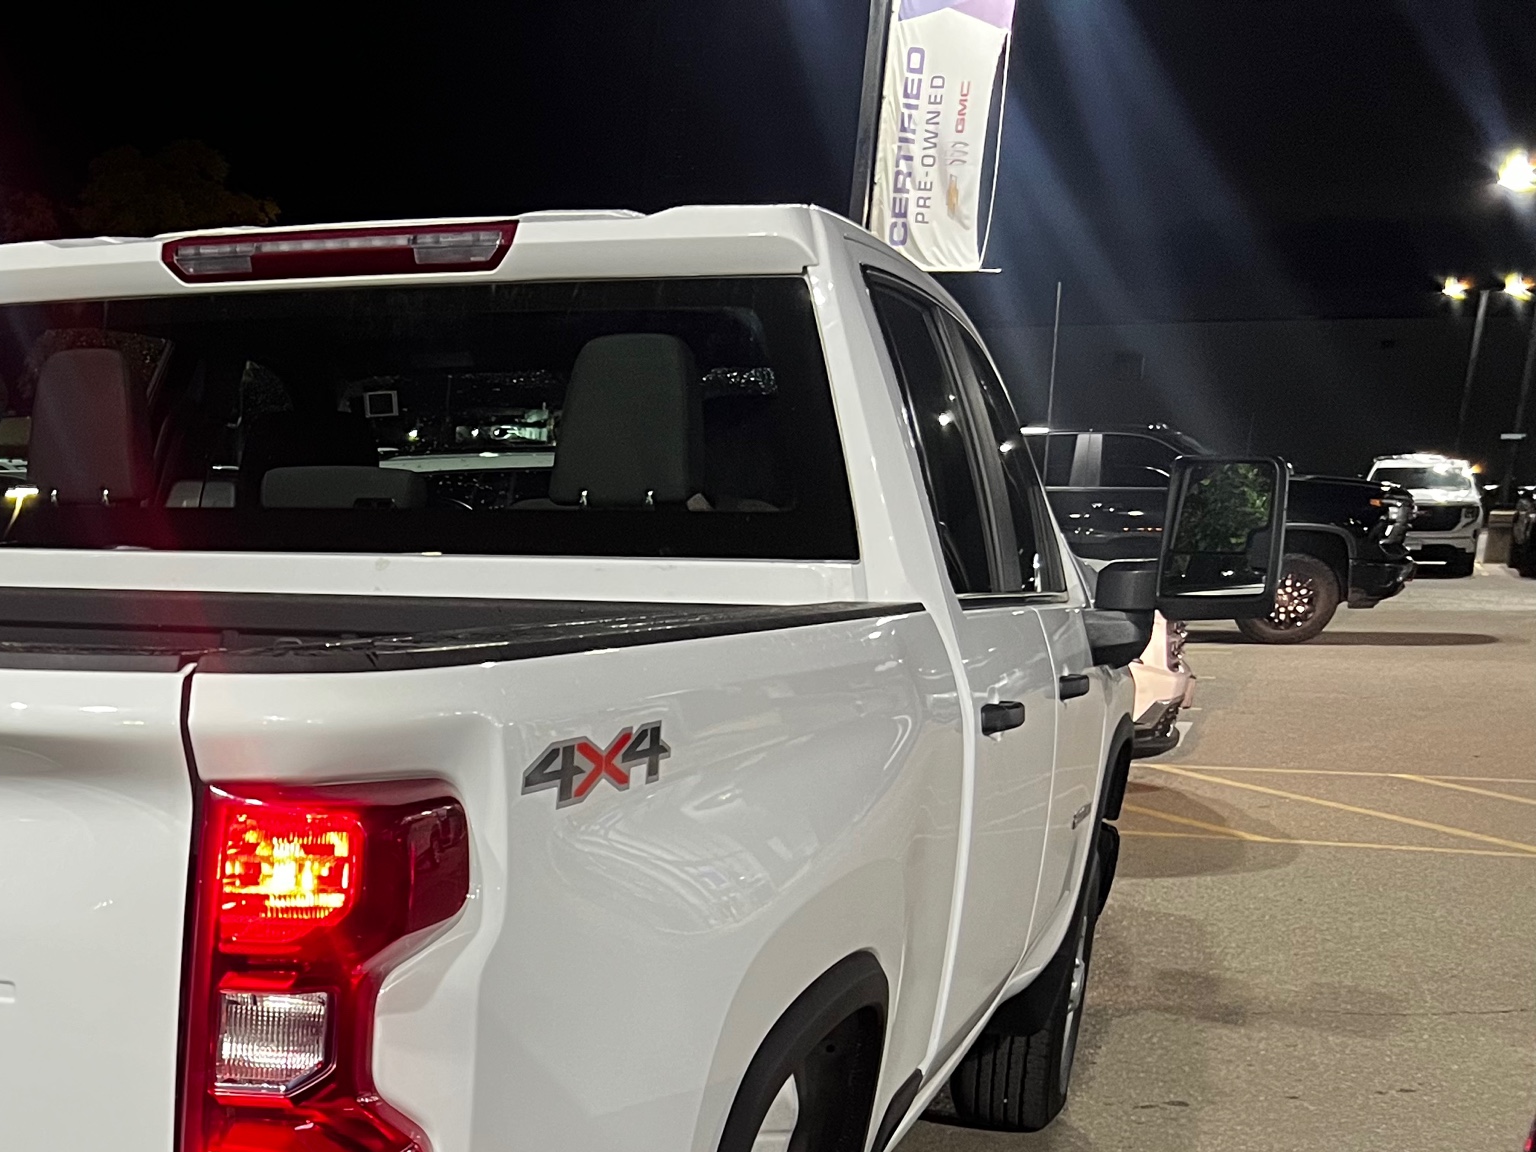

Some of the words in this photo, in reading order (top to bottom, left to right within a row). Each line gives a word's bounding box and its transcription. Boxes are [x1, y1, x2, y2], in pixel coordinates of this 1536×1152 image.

[889, 46, 925, 246] CERTIFIED
[915, 75, 945, 224] PRE-OWNED
[955, 80, 971, 134] GMC
